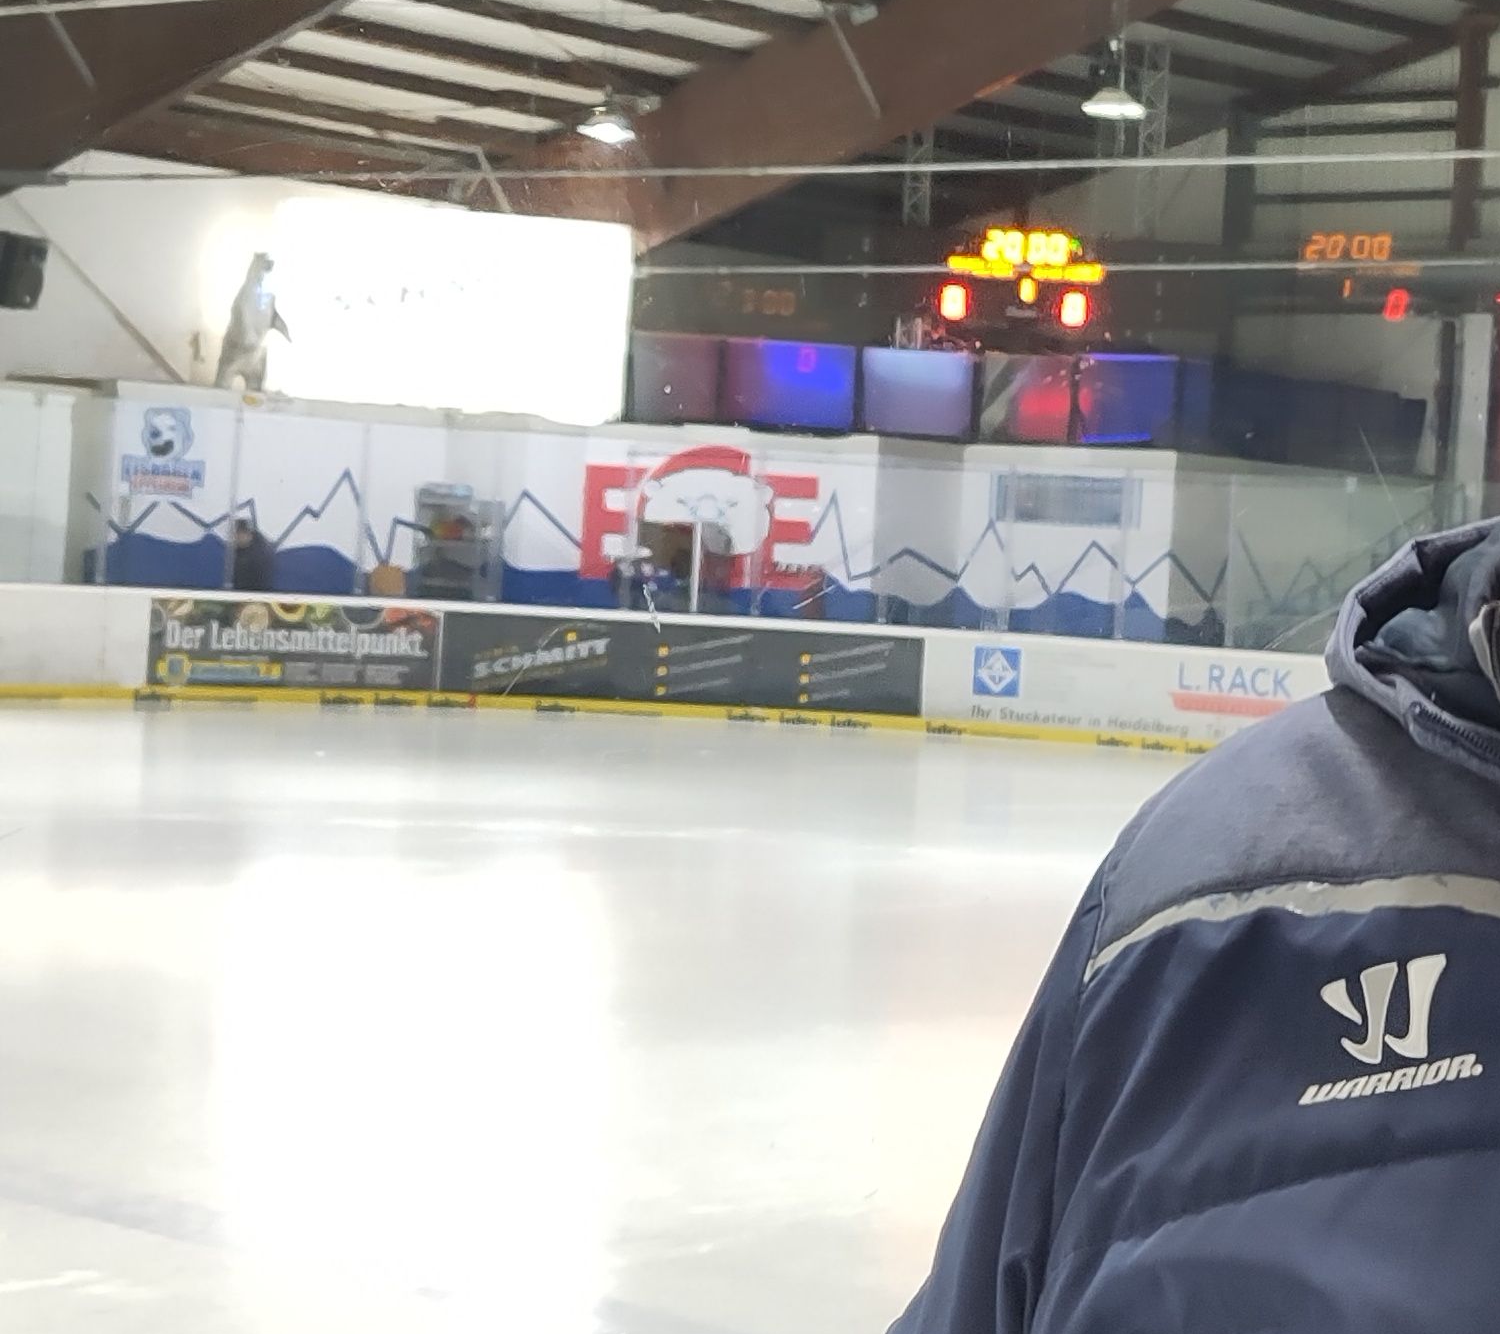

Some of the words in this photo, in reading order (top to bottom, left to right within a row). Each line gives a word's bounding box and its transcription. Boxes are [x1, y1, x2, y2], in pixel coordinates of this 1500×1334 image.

[165, 619, 205, 650] Der
[971, 704, 992, 720] Ihr
[1000, 706, 1082, 725] Stuckateur
[1108, 715, 1188, 738] Heidelberg
